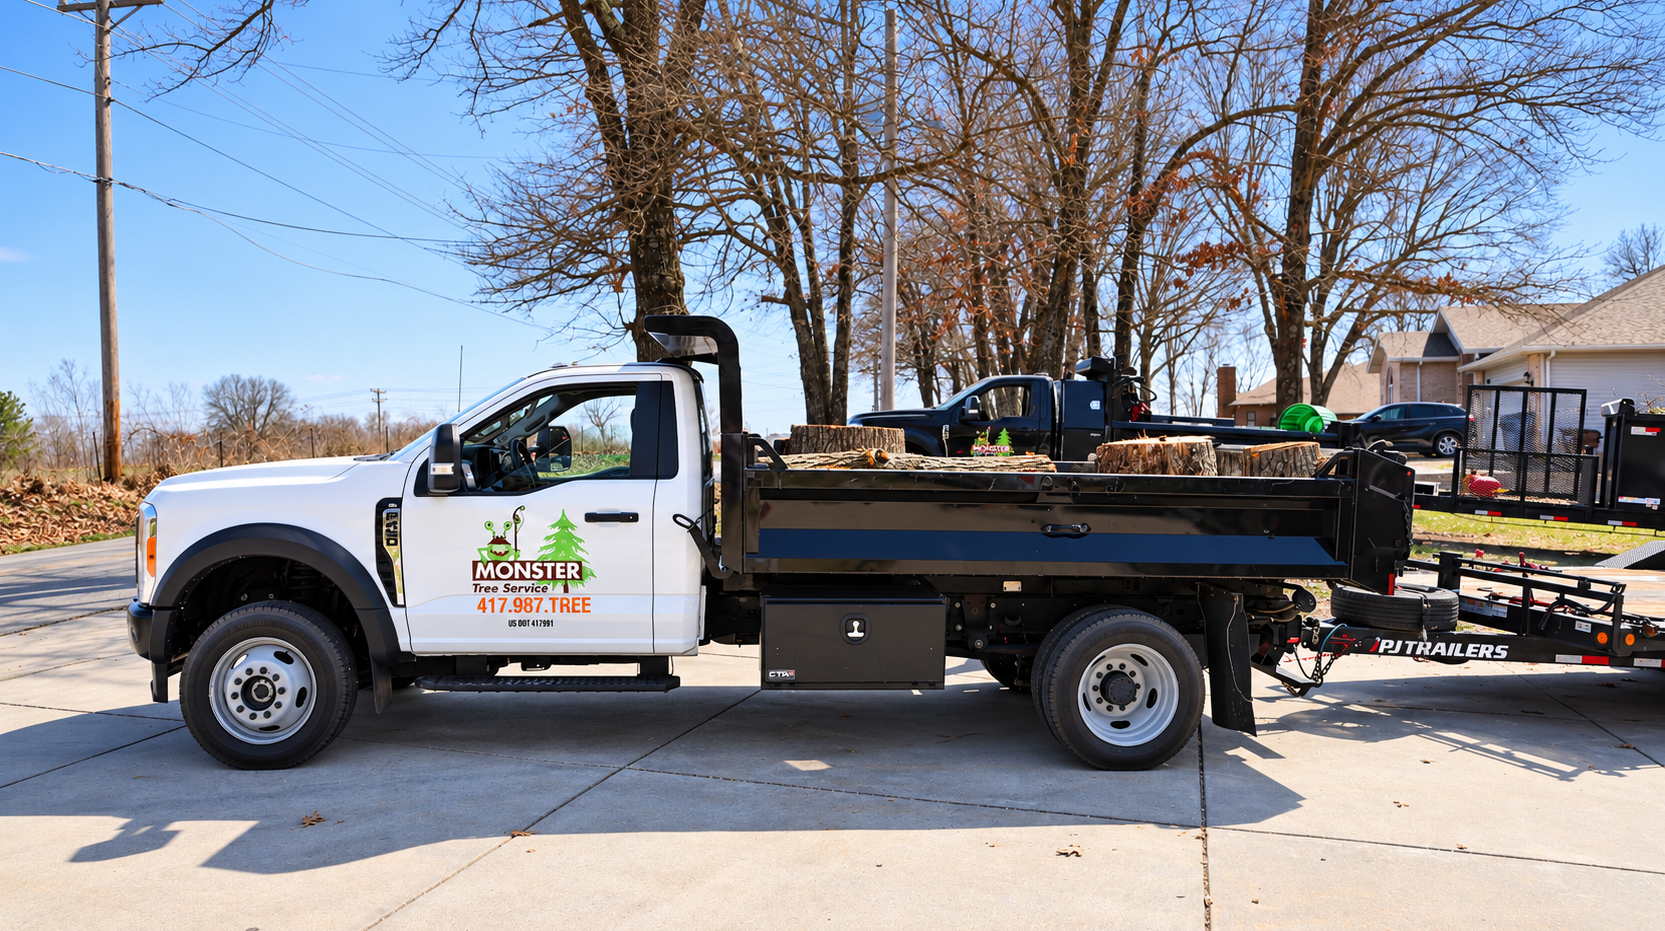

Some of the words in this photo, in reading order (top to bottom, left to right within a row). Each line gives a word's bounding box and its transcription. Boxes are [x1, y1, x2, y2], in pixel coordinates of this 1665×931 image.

[475, 562, 581, 579] MONSTER
[472, 583, 499, 593] Tree
[502, 583, 549, 593] Service
[477, 597, 591, 613] 417.987.TREE
[508, 619, 517, 627] US
[531, 619, 554, 627] 417991
[1378, 639, 1403, 653] PJ
[1405, 640, 1509, 659] TRAILERS
